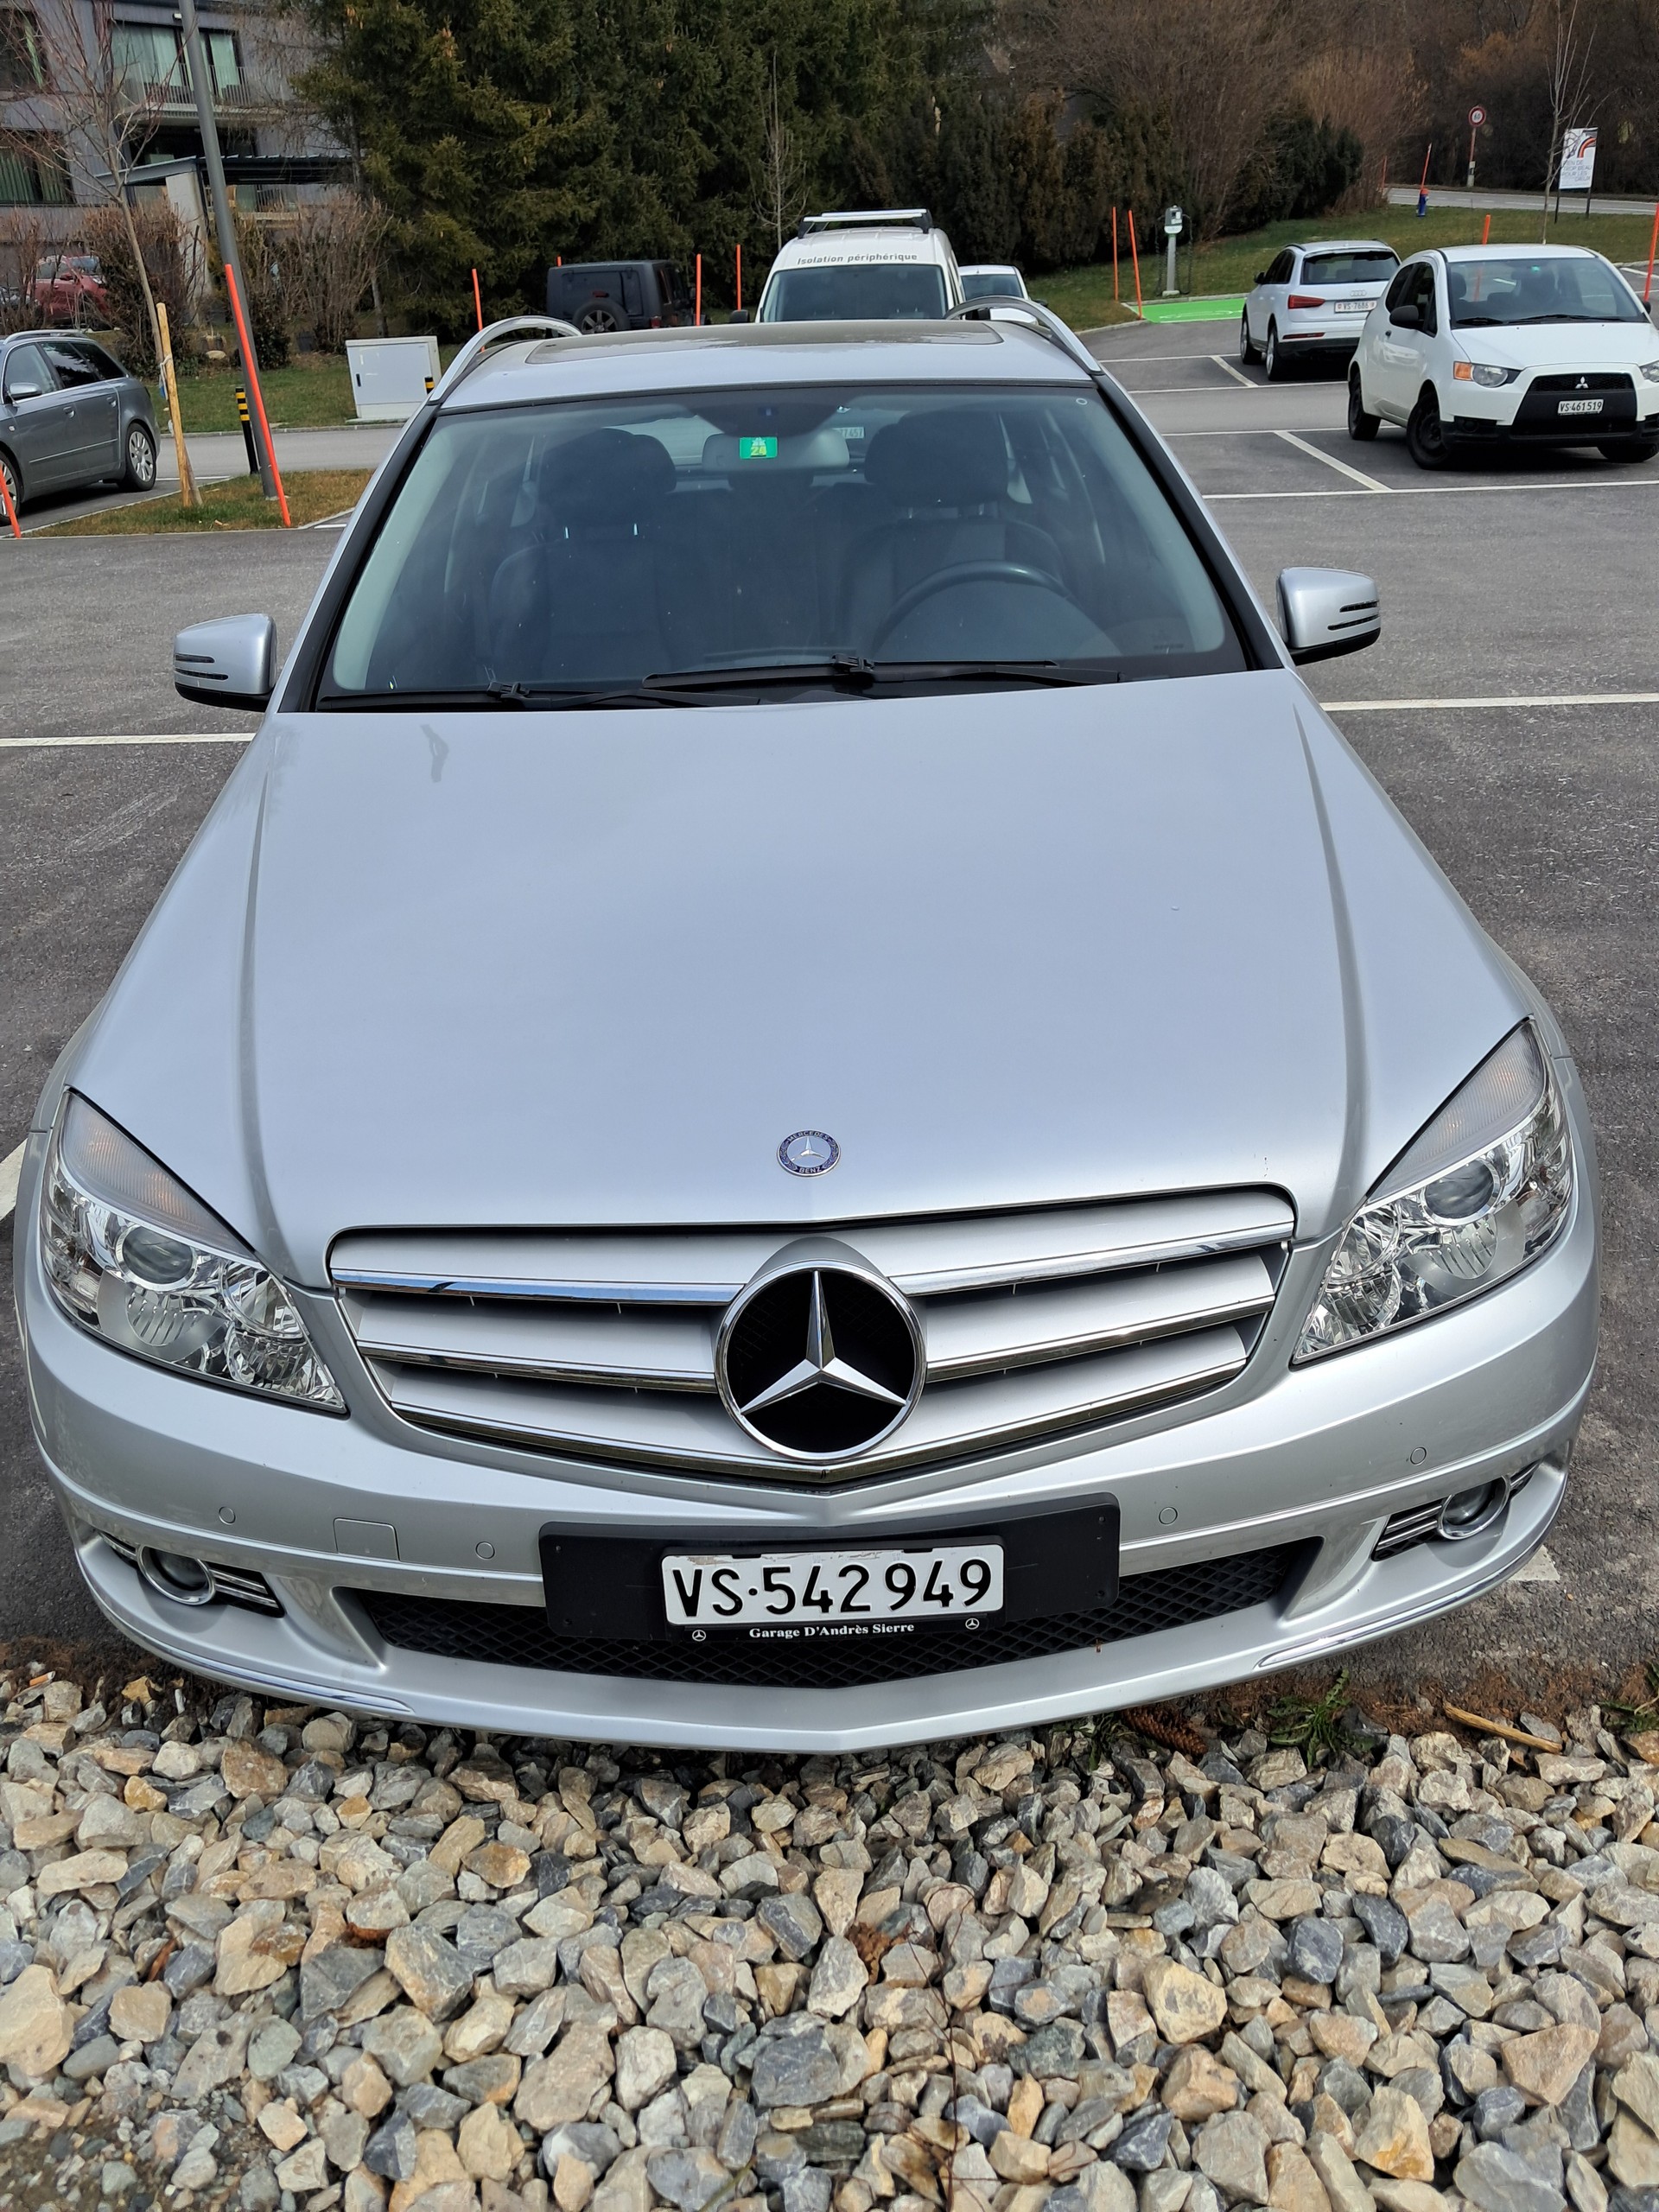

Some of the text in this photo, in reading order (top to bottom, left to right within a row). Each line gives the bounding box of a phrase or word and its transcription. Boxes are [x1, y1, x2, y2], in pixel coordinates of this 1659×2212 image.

[797, 253, 918, 265] Isolation périphérique
[787, 1131, 830, 1141] MERCEDES
[749, 1624, 914, 1639] Garage D'Andrès Sierre
